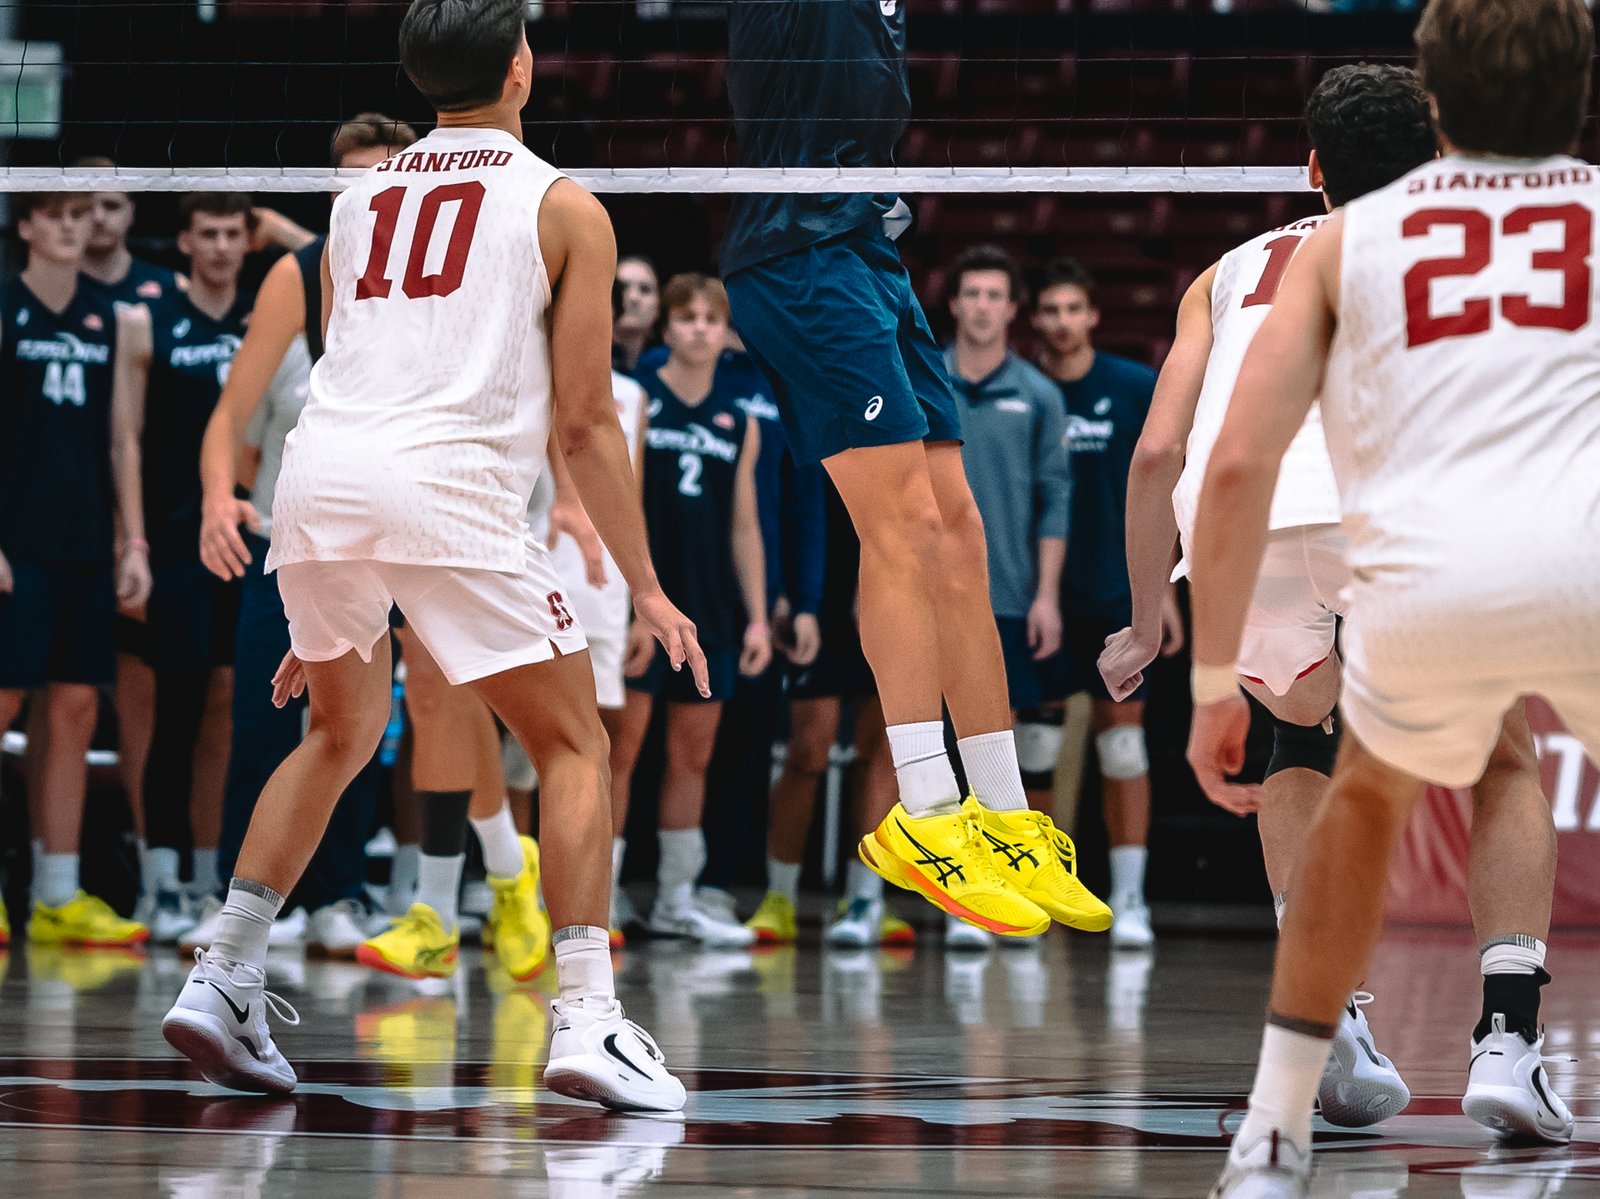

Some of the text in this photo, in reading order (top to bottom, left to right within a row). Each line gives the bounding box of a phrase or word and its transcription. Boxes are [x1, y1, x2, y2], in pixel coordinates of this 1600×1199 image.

[376, 149, 513, 173] STANFORD
[1408, 167, 1593, 195] STANFORD
[355, 180, 486, 301] 10
[1401, 202, 1593, 349] 23
[42, 360, 86, 407] 44
[677, 451, 703, 497] 2
